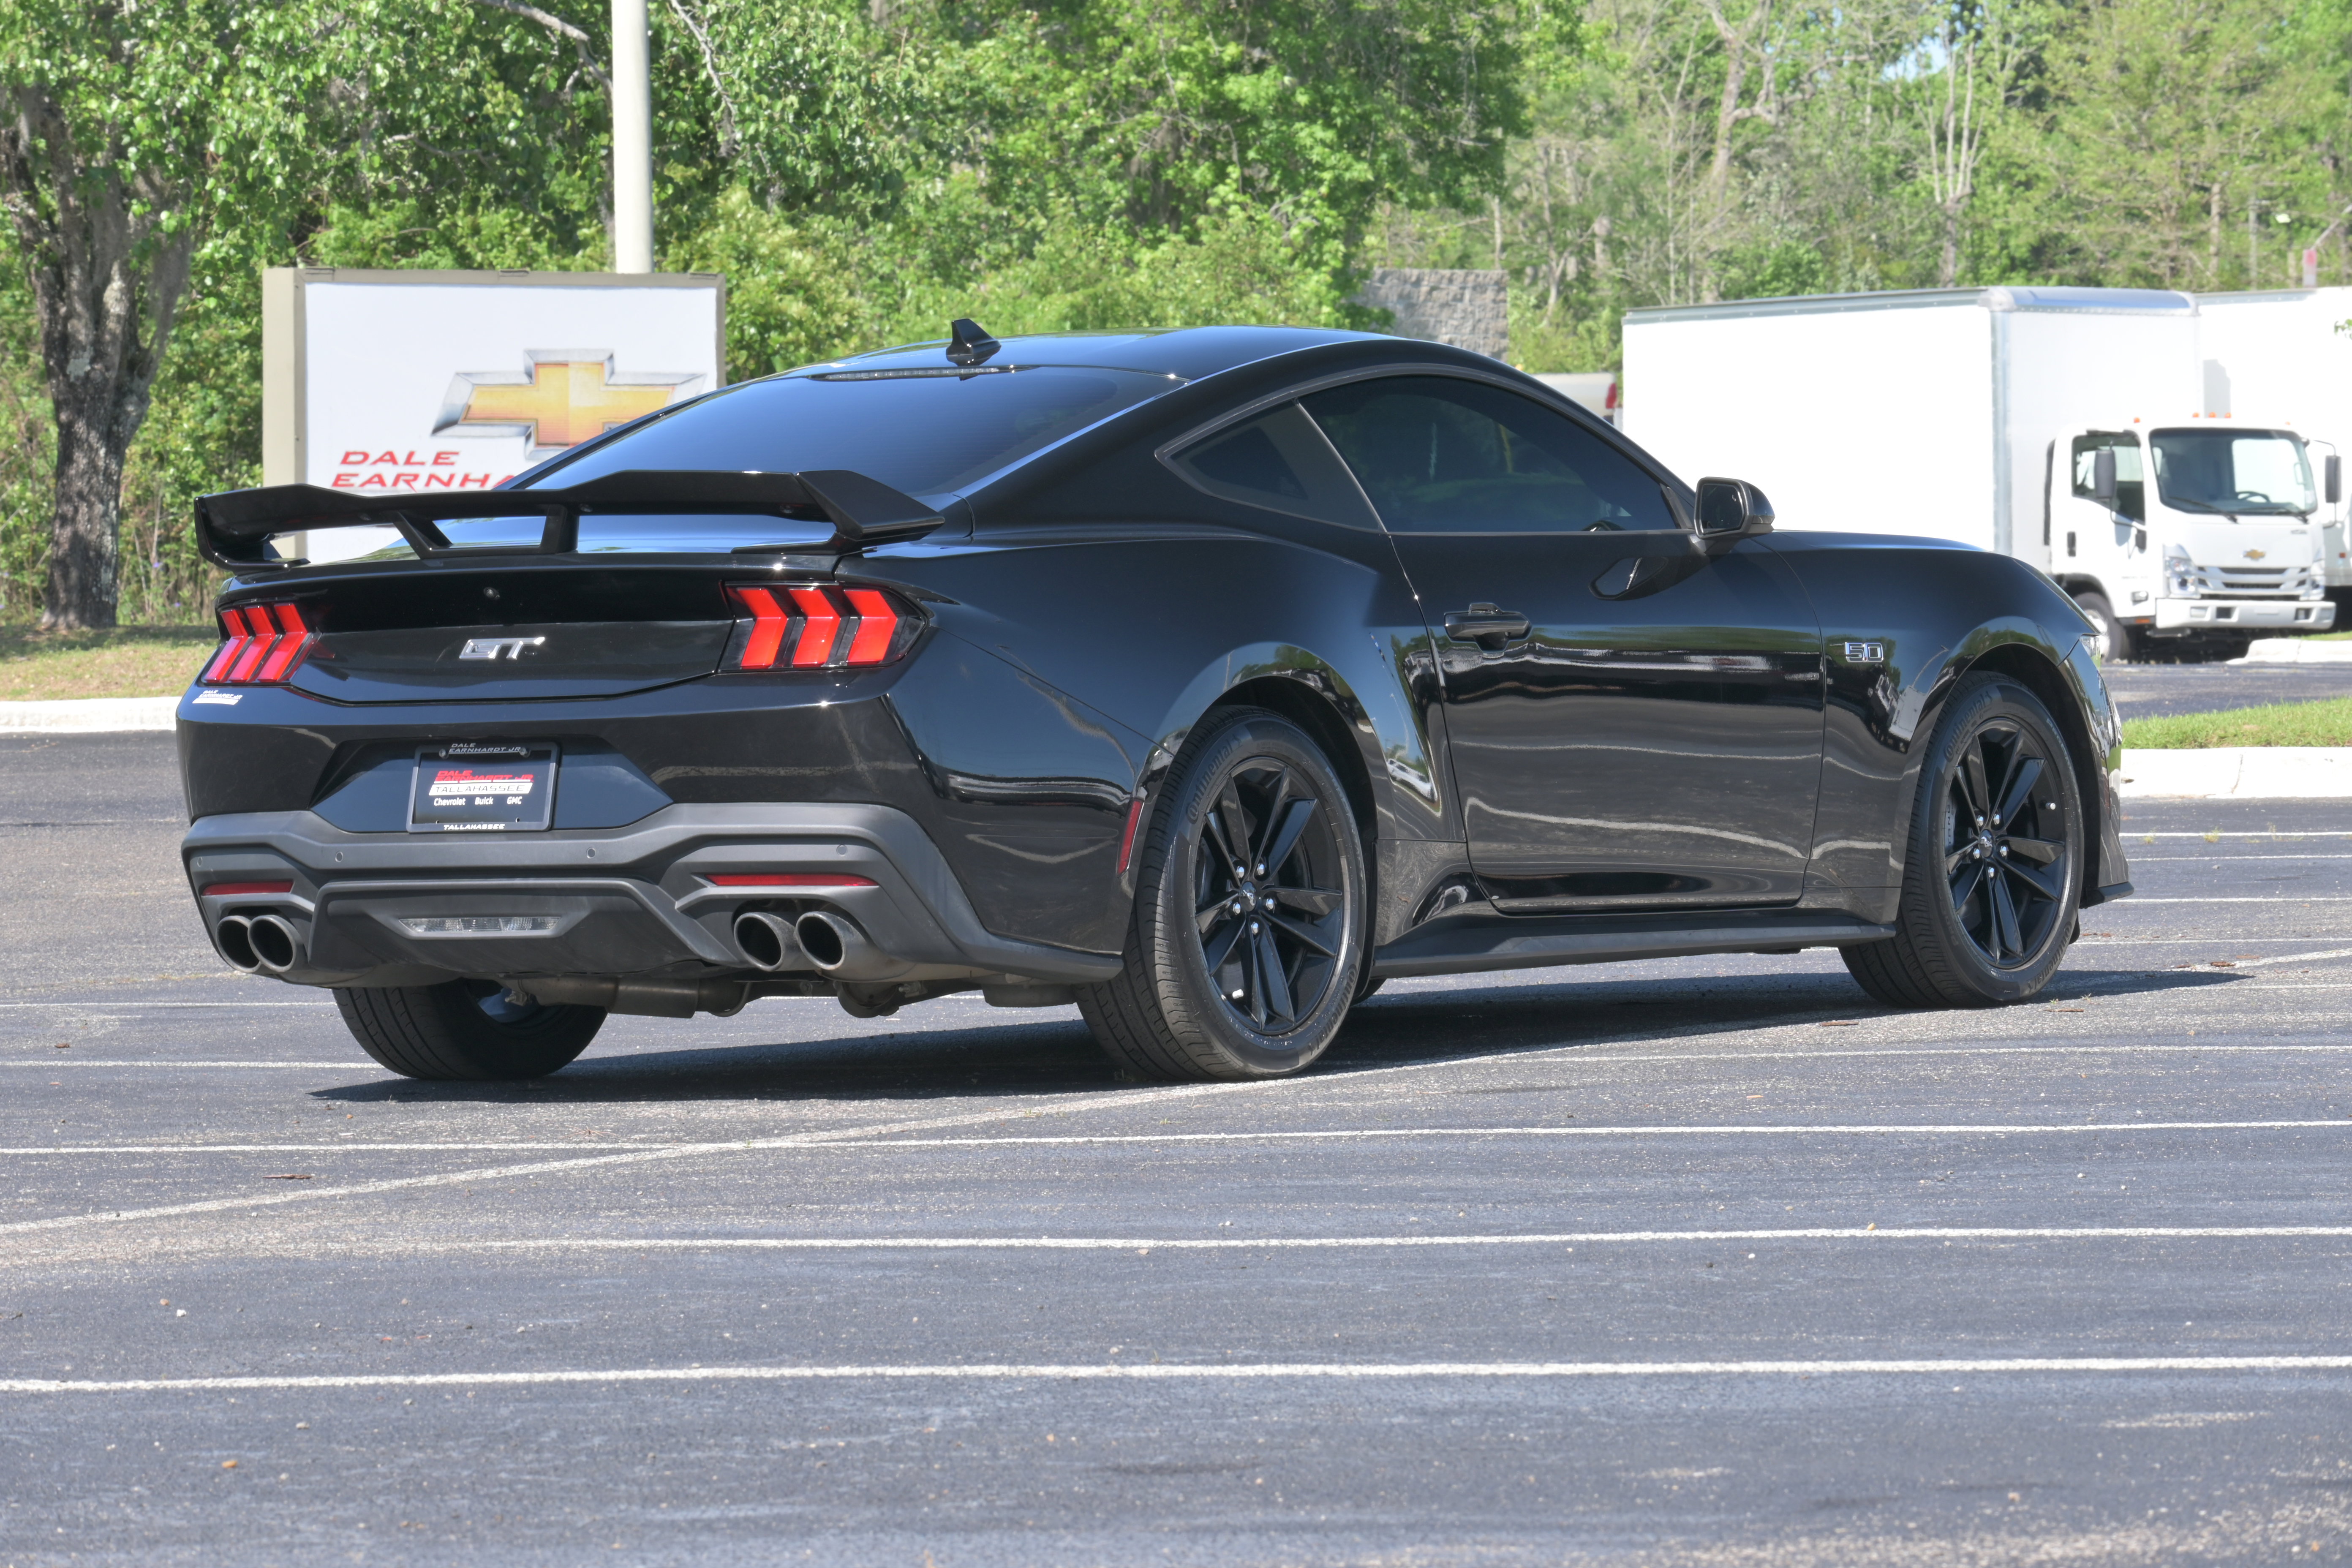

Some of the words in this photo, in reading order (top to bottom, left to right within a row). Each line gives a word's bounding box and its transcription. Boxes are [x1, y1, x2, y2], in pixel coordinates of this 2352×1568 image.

[340, 450, 460, 466] DALE
[459, 637, 546, 660] GT
[1944, 693, 1986, 763] Continental
[1186, 741, 1234, 825] Continental
[433, 797, 466, 806] Chevrolet
[474, 796, 494, 805] Buick
[506, 796, 523, 805] GMC
